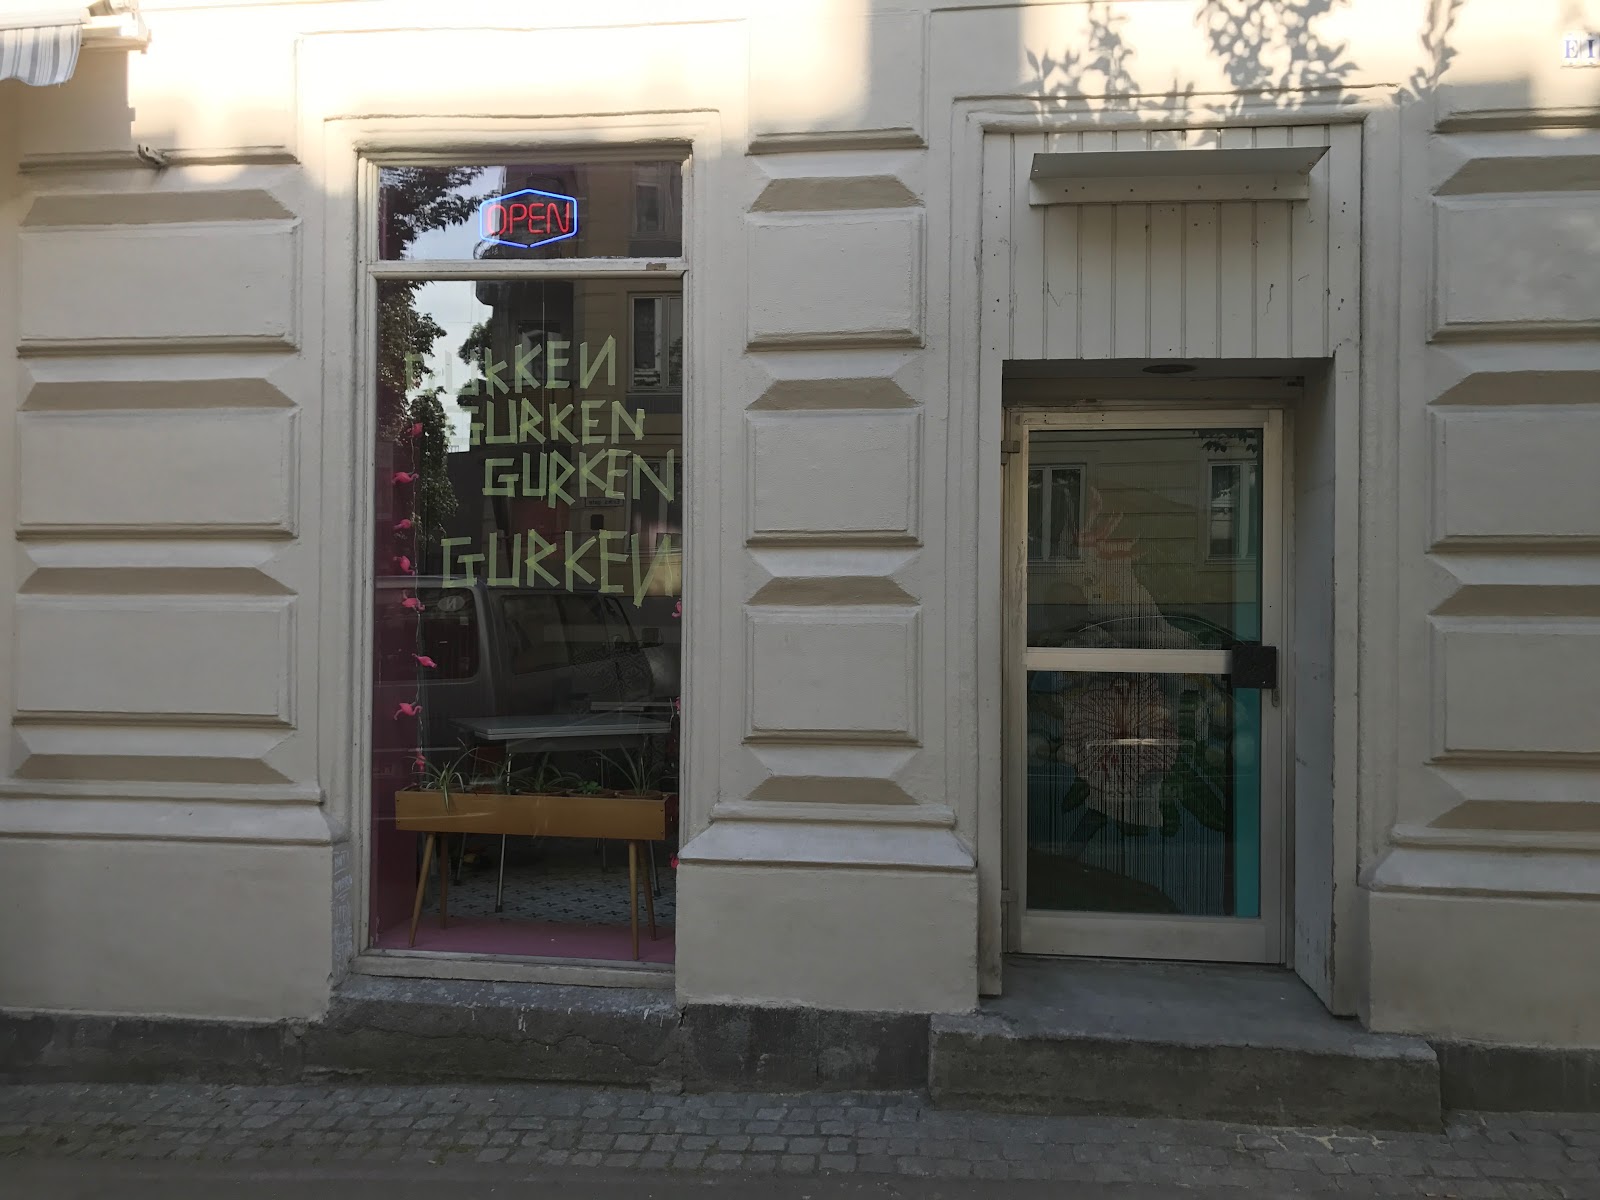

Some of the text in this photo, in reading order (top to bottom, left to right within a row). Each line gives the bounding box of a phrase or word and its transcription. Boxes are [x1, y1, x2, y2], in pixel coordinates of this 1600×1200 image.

[486, 201, 571, 236] OPEN
[445, 397, 646, 446] GURKEN
[482, 448, 675, 509] GURKEN
[440, 528, 674, 608] GURKEN
